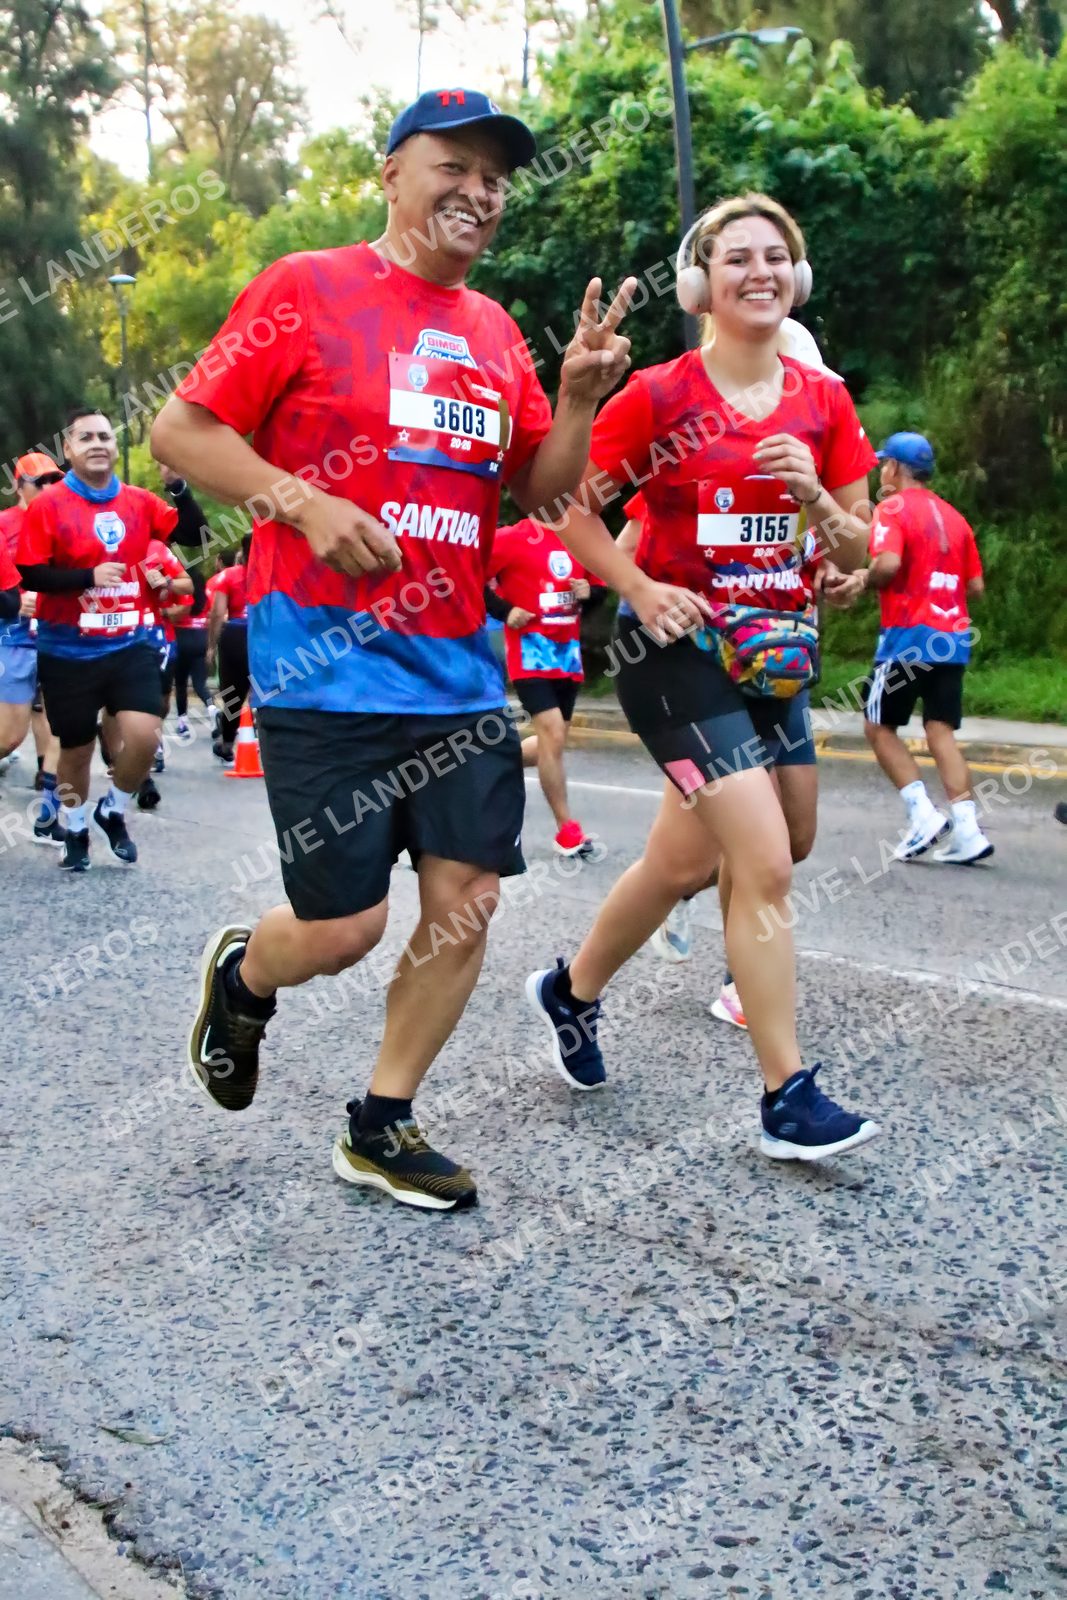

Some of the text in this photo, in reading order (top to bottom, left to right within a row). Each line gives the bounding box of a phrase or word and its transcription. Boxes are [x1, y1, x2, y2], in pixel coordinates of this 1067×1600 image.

[436, 89, 465, 107] 11
[427, 336, 464, 353] BIMBO
[433, 398, 485, 437] 3603
[740, 516, 790, 542] 3155
[102, 613, 123, 625] 1851
